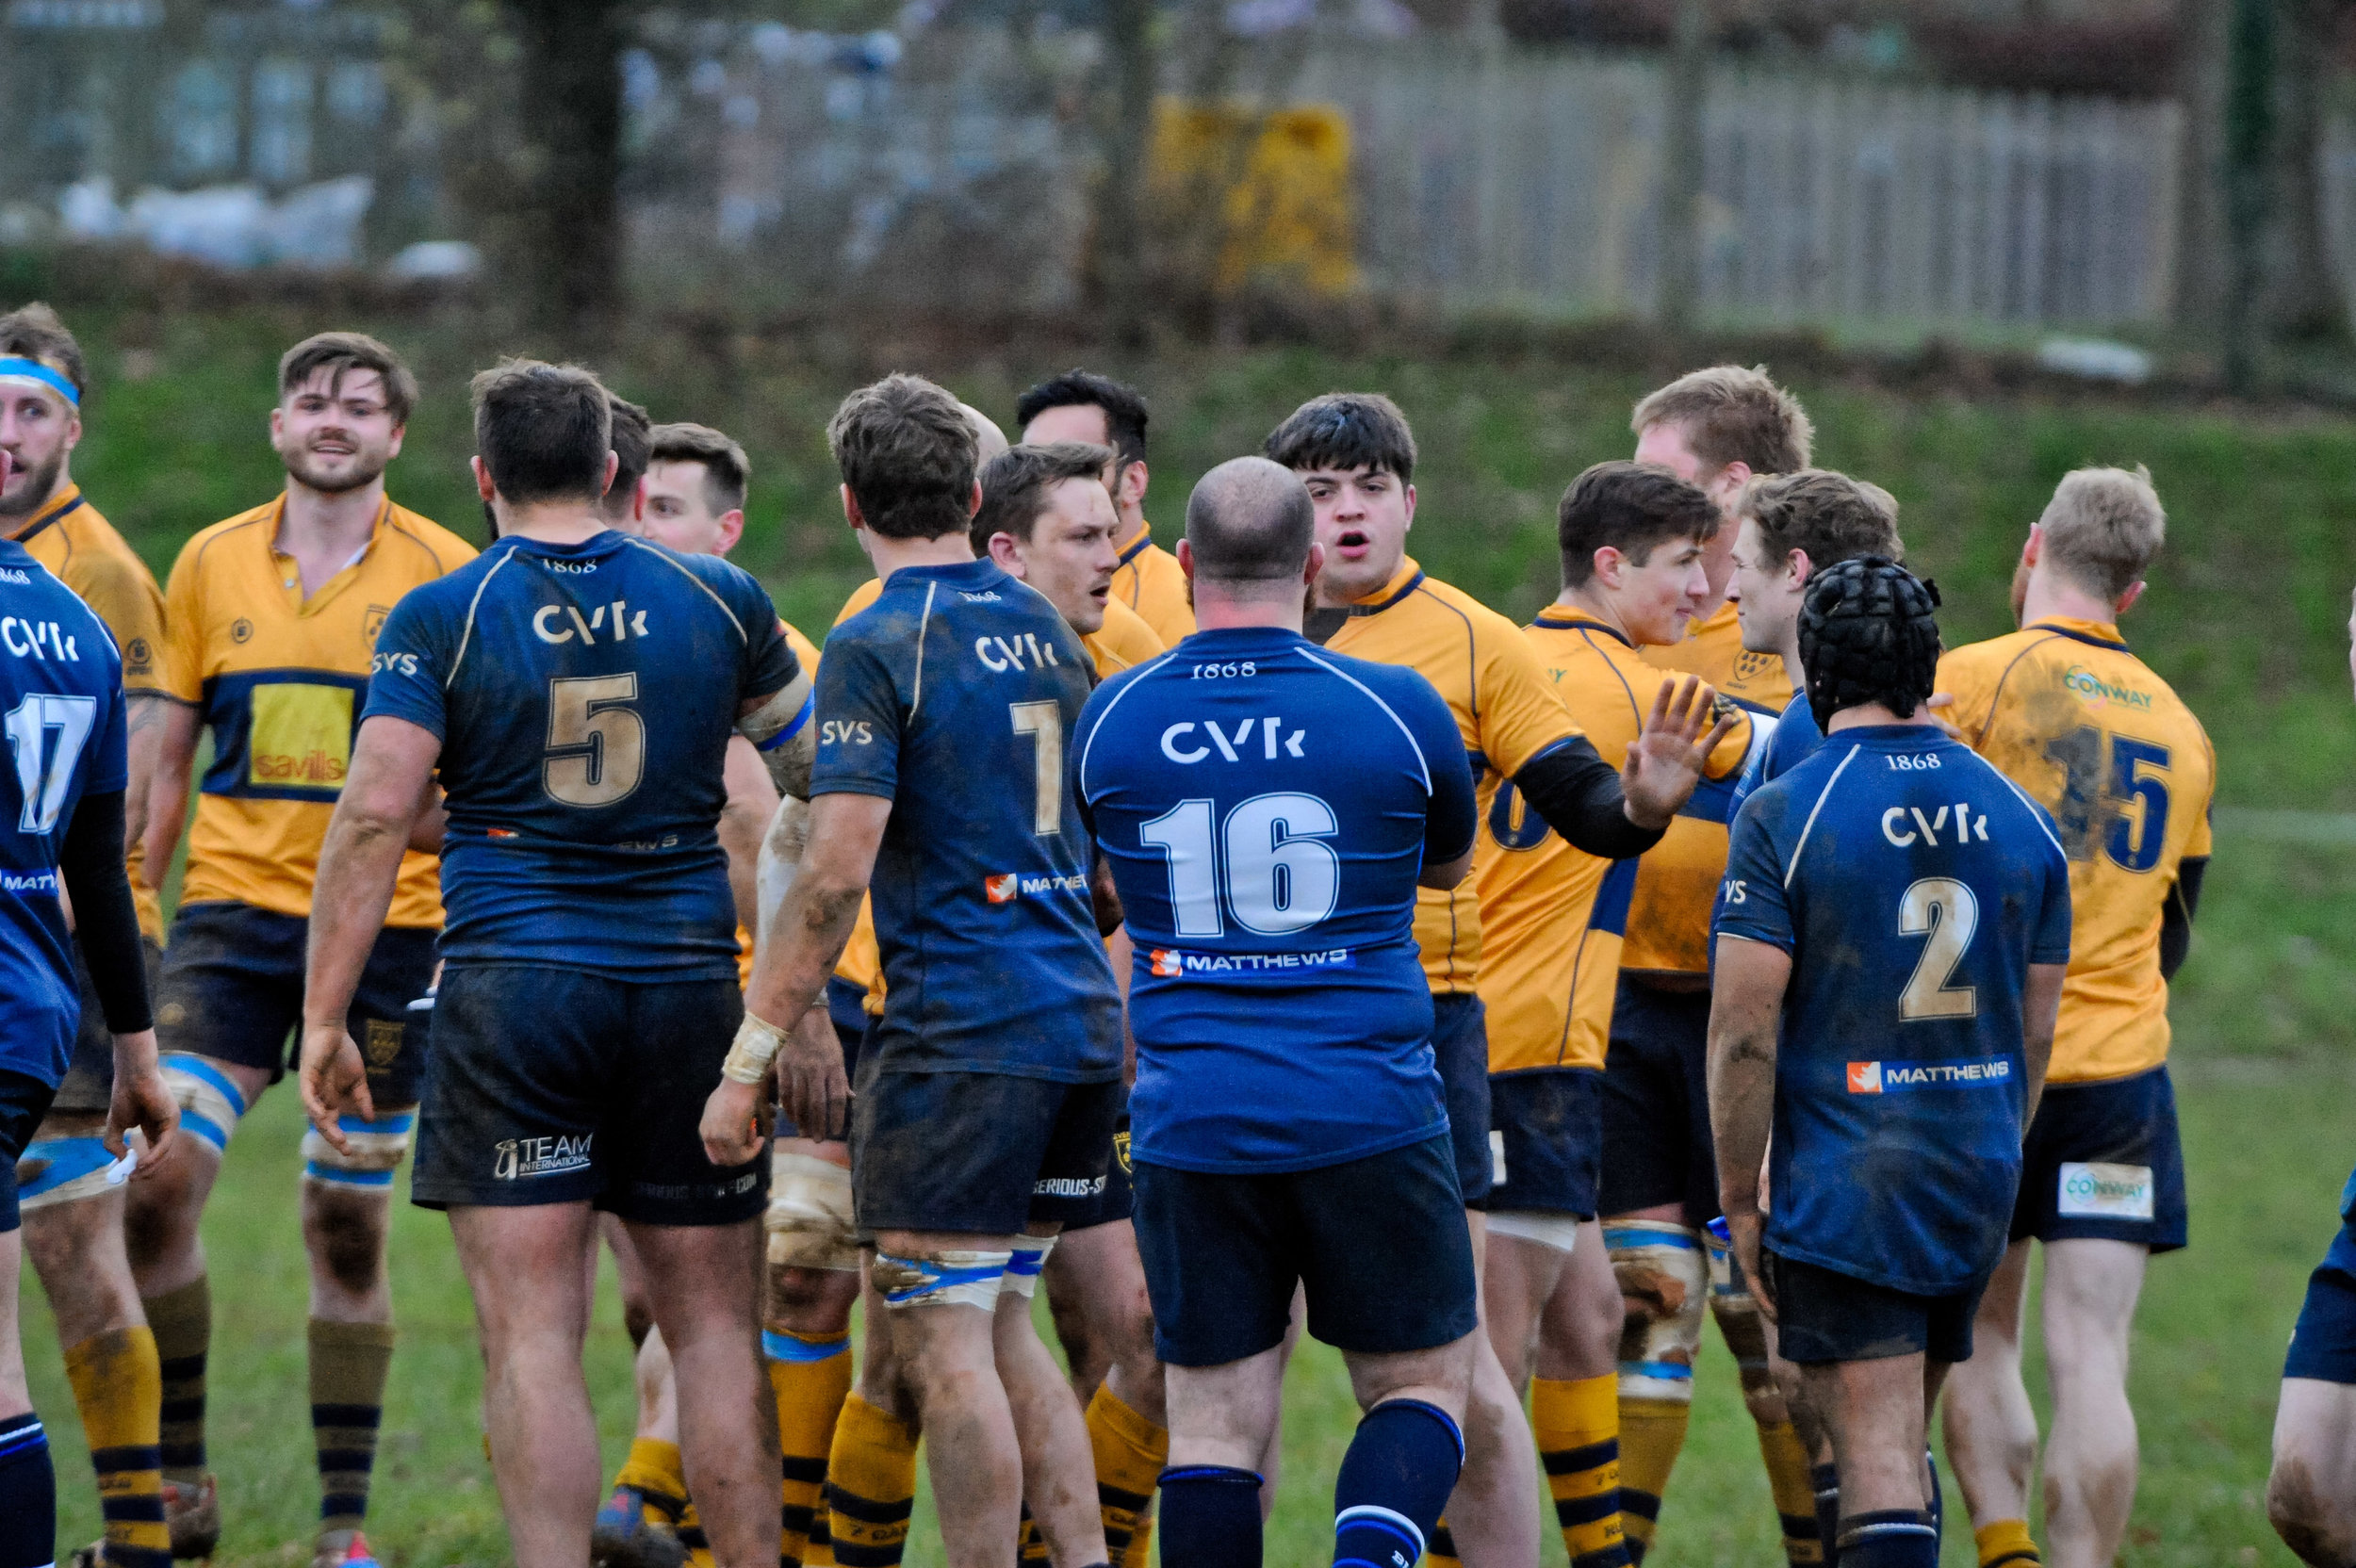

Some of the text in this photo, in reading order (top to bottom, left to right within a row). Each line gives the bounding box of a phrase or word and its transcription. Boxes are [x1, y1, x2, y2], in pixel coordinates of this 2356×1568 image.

[0, 566, 31, 584] 868
[543, 558, 597, 574] 1868
[1189, 662, 1257, 680] 1868
[2064, 670, 2152, 709] CONWAY
[542, 672, 646, 808] 5
[4, 692, 97, 836] 17
[1886, 753, 1941, 771] 1868
[1139, 792, 1340, 939] 16
[1186, 948, 1349, 972] MATTHEWS
[1897, 876, 1979, 1023] 2
[1887, 1060, 2010, 1085] MATTHEWS
[519, 1132, 595, 1162] TEAM
[519, 1153, 591, 1172] INTERNATIONAL
